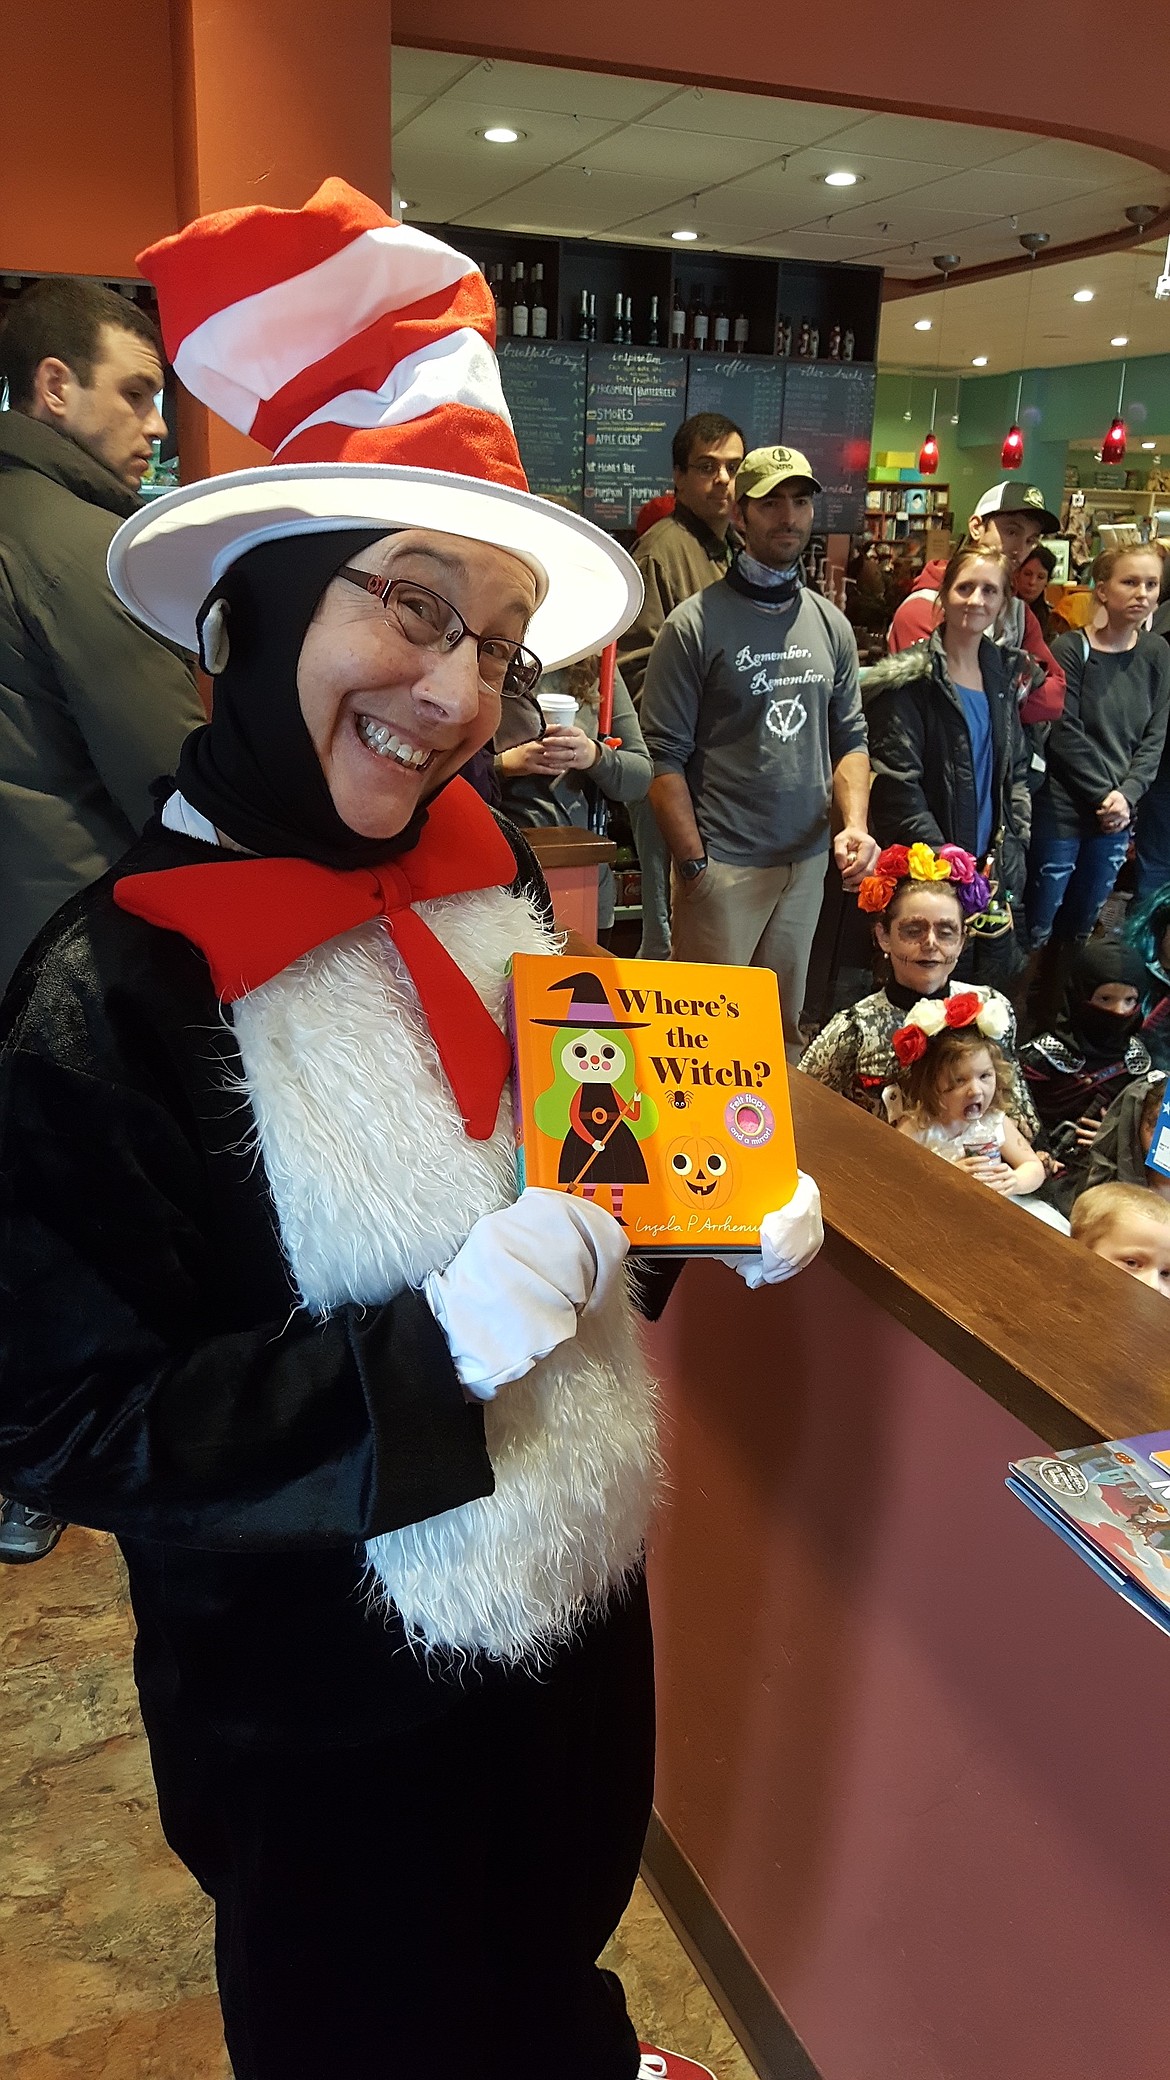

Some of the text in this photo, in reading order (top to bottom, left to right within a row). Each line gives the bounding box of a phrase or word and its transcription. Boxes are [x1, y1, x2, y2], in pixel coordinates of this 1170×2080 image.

[503, 342, 554, 362] breakfast
[715, 359, 752, 378] coffee
[595, 433, 643, 446] APPLE CRISP
[595, 487, 623, 498] PUMPKIN
[632, 487, 661, 498] PUMPKIN
[615, 988, 740, 1019] Where's
[666, 1026, 709, 1049] the
[648, 1056, 771, 1088] Witch?
[729, 1093, 767, 1111] Felt flaps
[730, 1127, 745, 1141] and
[751, 1127, 772, 1145] mirror!
[635, 1215, 683, 1237] Ingela
[687, 1214, 699, 1232] P
